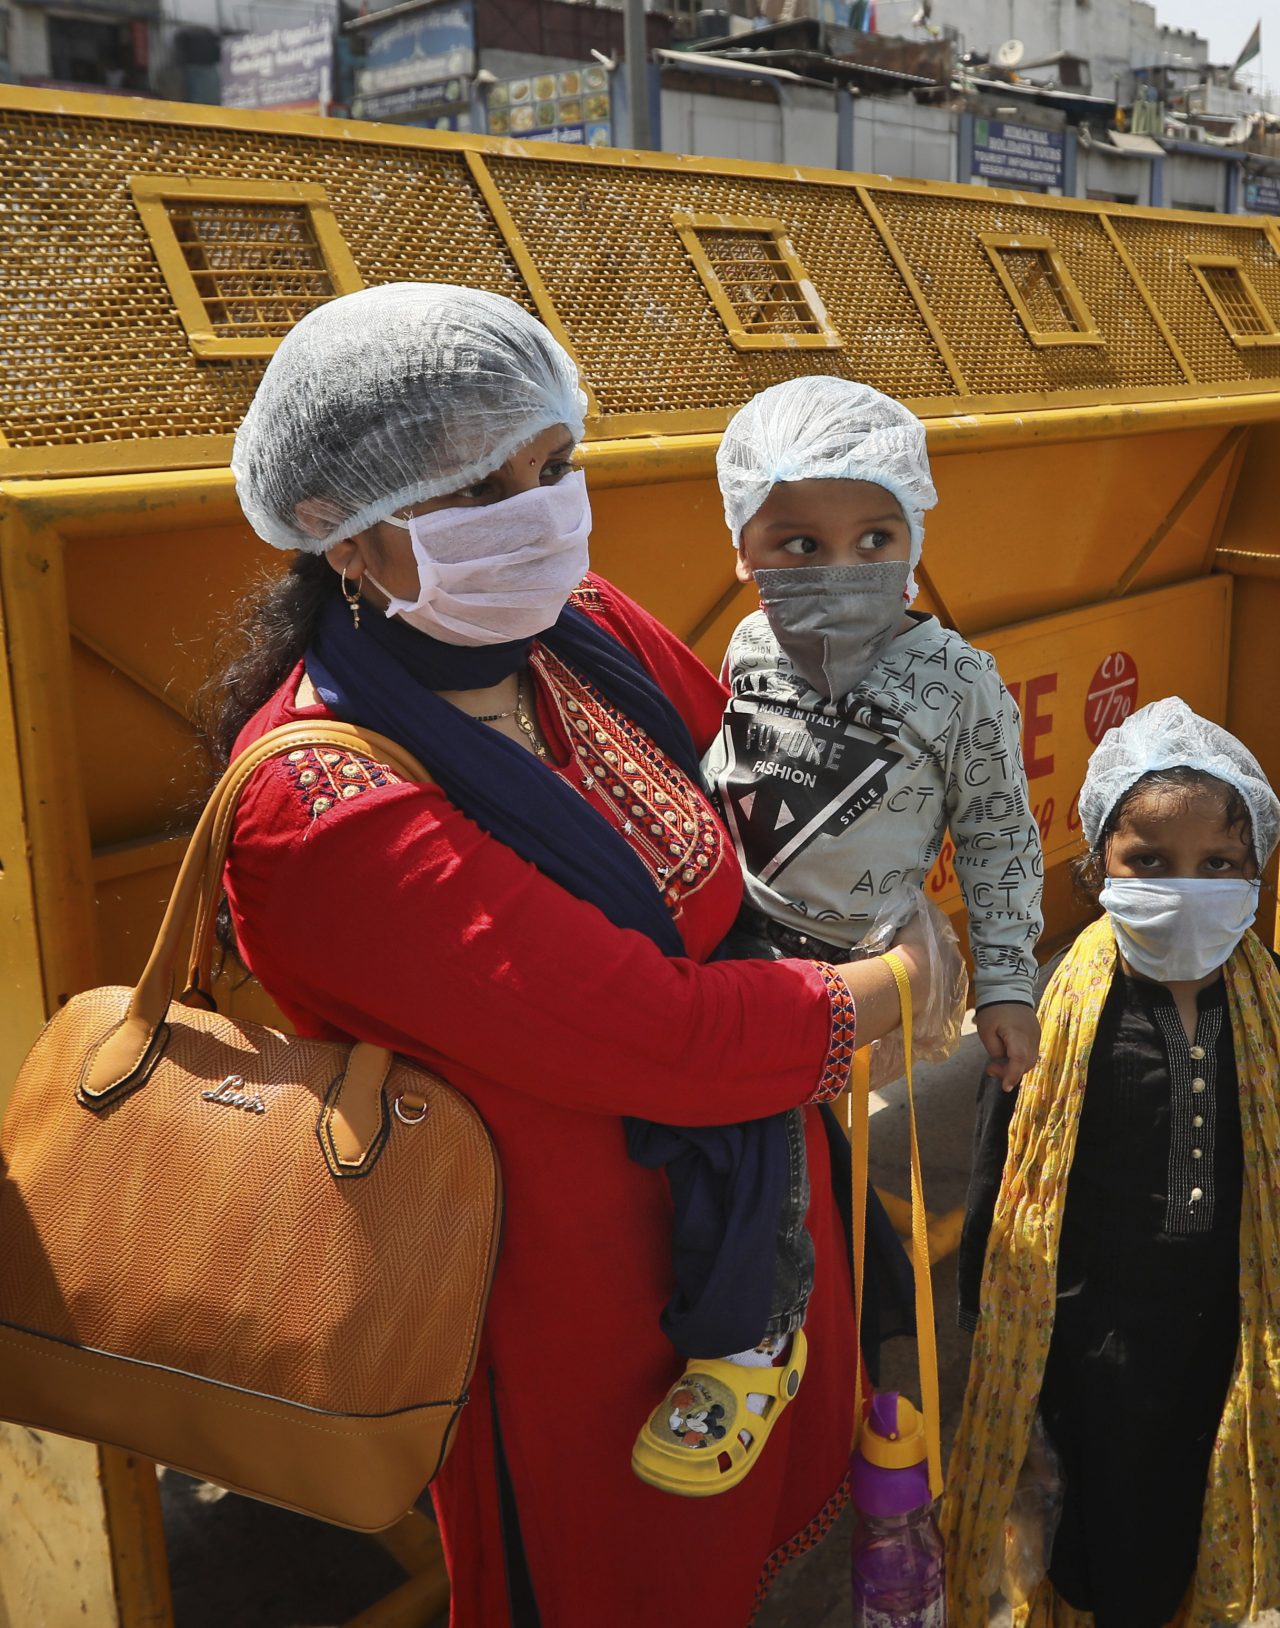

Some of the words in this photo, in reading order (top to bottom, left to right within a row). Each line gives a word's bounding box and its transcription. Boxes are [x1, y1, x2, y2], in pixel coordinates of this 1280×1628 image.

[1003, 124, 1049, 145] HIMACHAL
[988, 136, 1032, 157] HOLIDAYS
[1034, 144, 1062, 161] TOURS
[974, 150, 1006, 164] TOURIST
[1007, 156, 1055, 174] INFORMATION
[979, 163, 1029, 180] RESERVATION
[1101, 653, 1125, 679] CD
[758, 703, 790, 717] MADE
[792, 710, 804, 720] IN
[805, 711, 842, 729] ITALY
[746, 721, 846, 771] FUTURE
[752, 760, 817, 789] FASHION
[840, 788, 879, 825] STYLE
[985, 911, 1032, 921] STYLE
